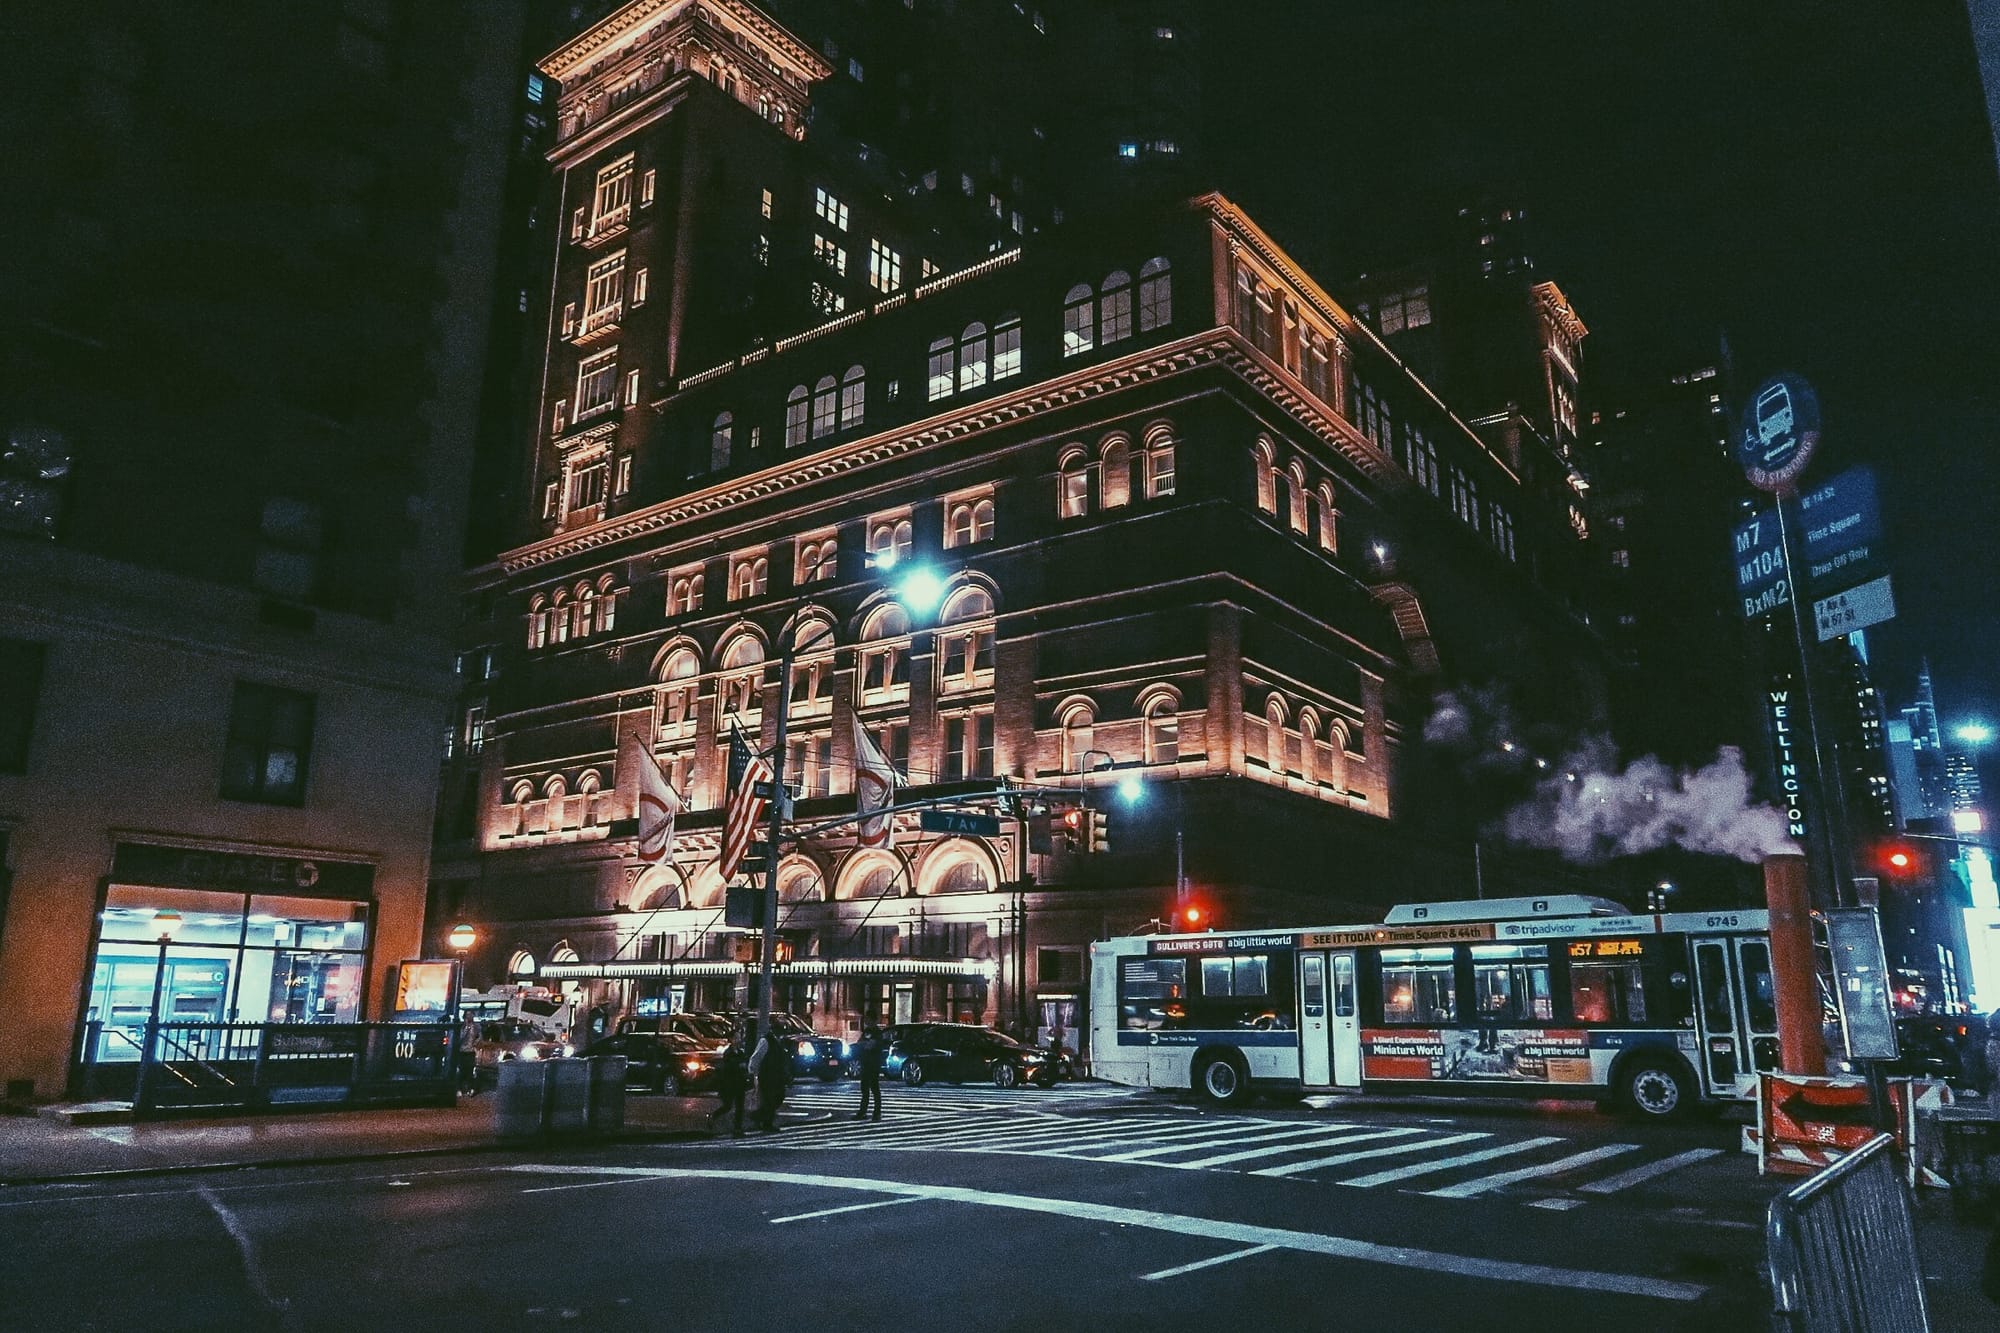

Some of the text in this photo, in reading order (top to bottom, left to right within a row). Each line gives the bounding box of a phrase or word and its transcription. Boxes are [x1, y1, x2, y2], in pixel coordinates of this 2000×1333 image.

[1736, 521, 1760, 552] M7
[1740, 545, 1783, 584] M104
[1744, 579, 1789, 617] BxM2
[1831, 613, 1843, 626] 57
[1769, 690, 1804, 836] WELLINGTON
[945, 816, 977, 830] 7 Av
[1706, 915, 1739, 928] 6745
[1388, 927, 1481, 941] Times Square & 44th
[1521, 923, 1576, 936] tripadvisor
[1227, 935, 1292, 950] a big little world
[1312, 930, 1376, 944] SEE IT TODAY
[1373, 1044, 1444, 1055] Miniature World
[1530, 1047, 1542, 1056] big
[1542, 1047, 1561, 1055] little
[1562, 1047, 1585, 1055] world
